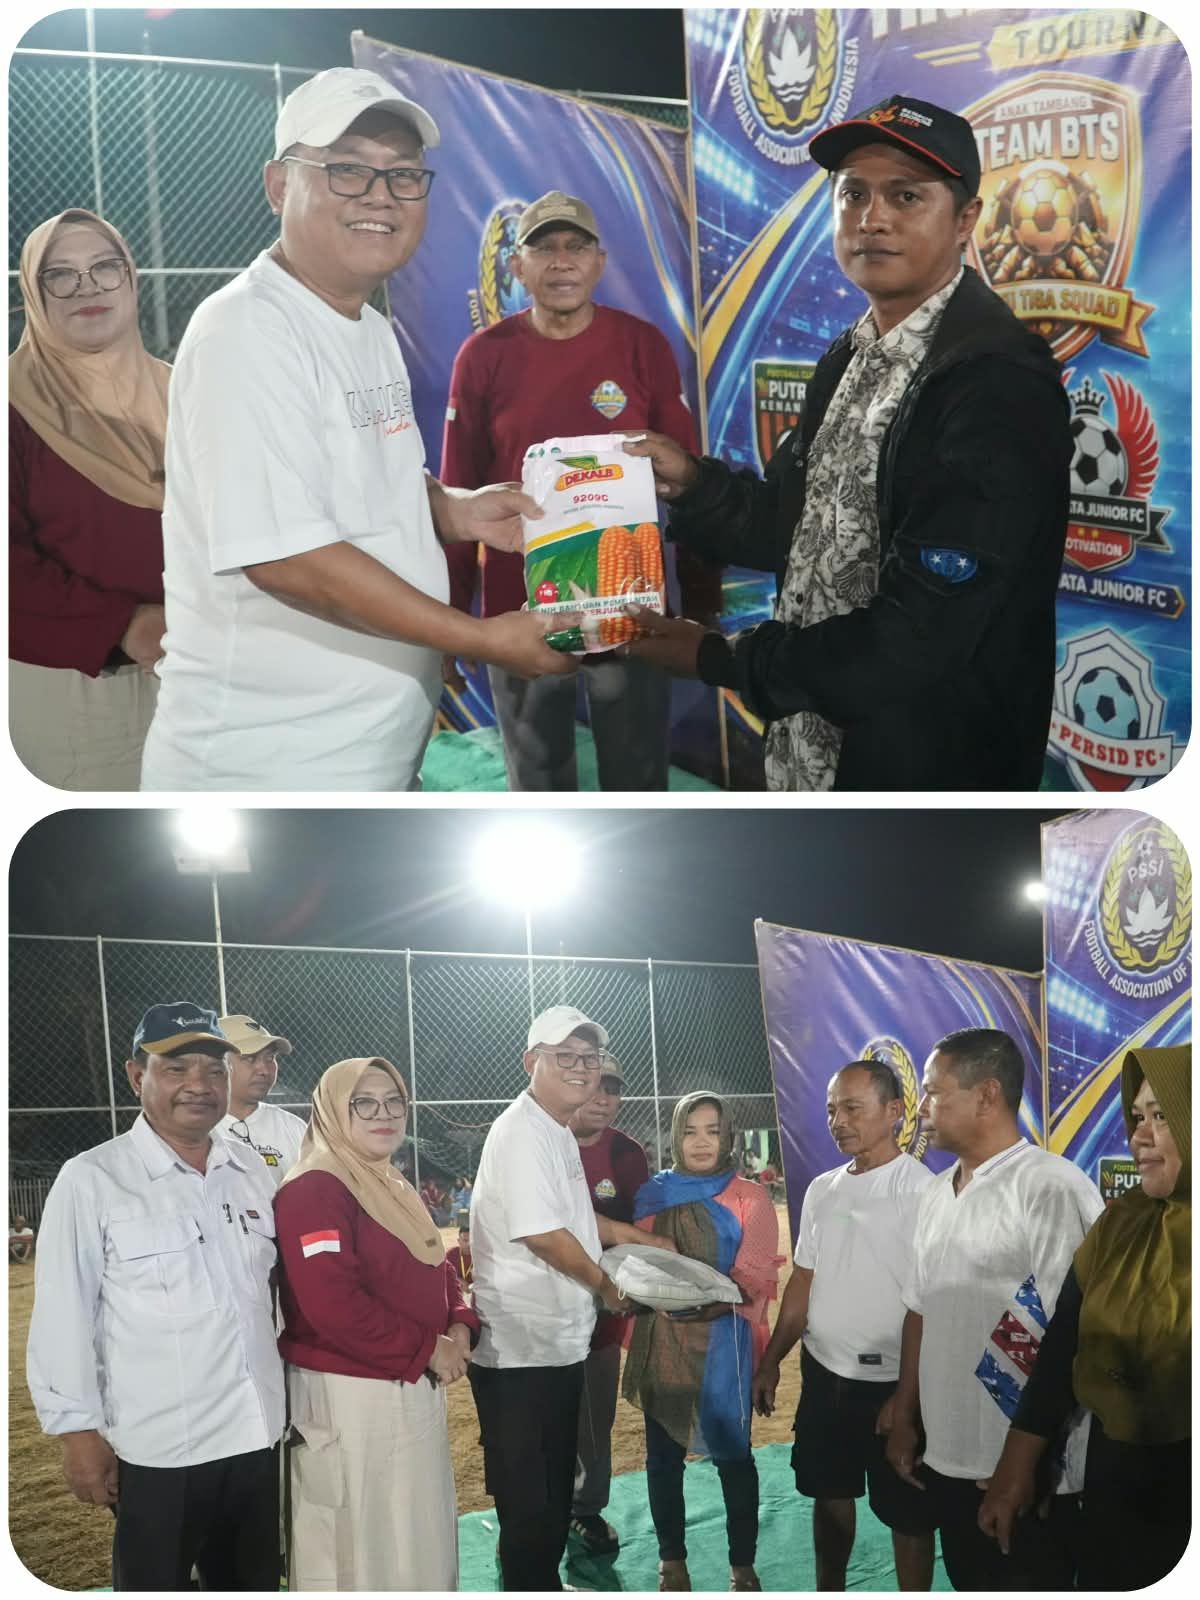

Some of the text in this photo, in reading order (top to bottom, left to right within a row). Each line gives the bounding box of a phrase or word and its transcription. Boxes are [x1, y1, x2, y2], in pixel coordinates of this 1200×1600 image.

[1000, 95, 1090, 118] ANAK TAMBANG
[976, 111, 1120, 174] TEAM BTS
[1060, 288, 1120, 318] SQUAD
[768, 380, 807, 401] PUTR
[565, 468, 614, 485] DEKALB
[573, 493, 609, 504] 9209C
[1086, 502, 1129, 521] JUNIOR
[1129, 508, 1145, 523] FC
[1065, 537, 1123, 557] OTIVATION
[1059, 572, 1167, 608] ATA JUNIOR FC
[1059, 724, 1157, 768] PERSID FC
[1127, 859, 1164, 884] PSSI
[1084, 919, 1189, 999] FOOTBALL ASSOCIATION OF
